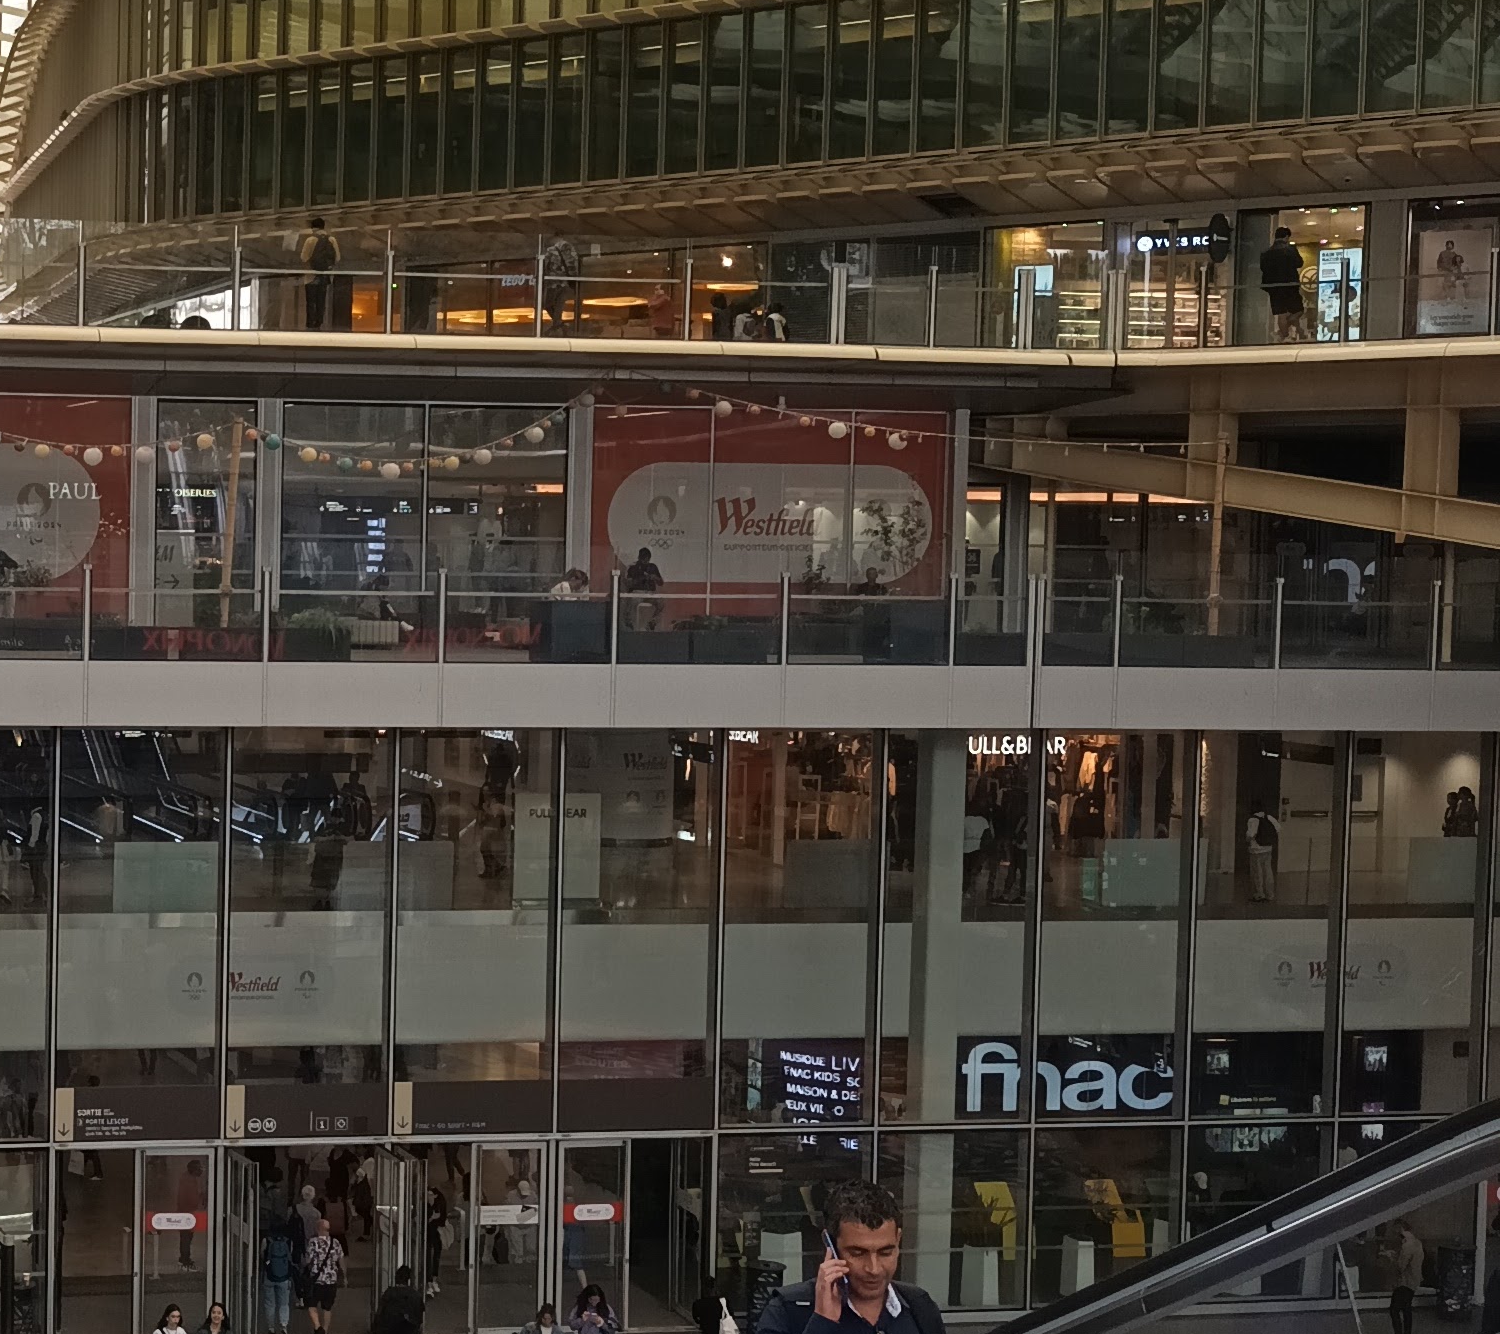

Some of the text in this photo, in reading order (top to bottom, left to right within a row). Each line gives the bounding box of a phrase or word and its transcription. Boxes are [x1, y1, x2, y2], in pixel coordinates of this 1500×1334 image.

[1155, 237, 1188, 247] YVS
[47, 482, 101, 500] PAUL
[780, 1050, 826, 1067] MUSIQUE
[783, 1065, 811, 1080] FNAC
[813, 1070, 841, 1083] KIDS
[961, 1042, 1174, 1112] fnac
[786, 1082, 828, 1099] MAISON
[830, 1089, 839, 1100] &
[77, 1108, 102, 1117] SORTIE
